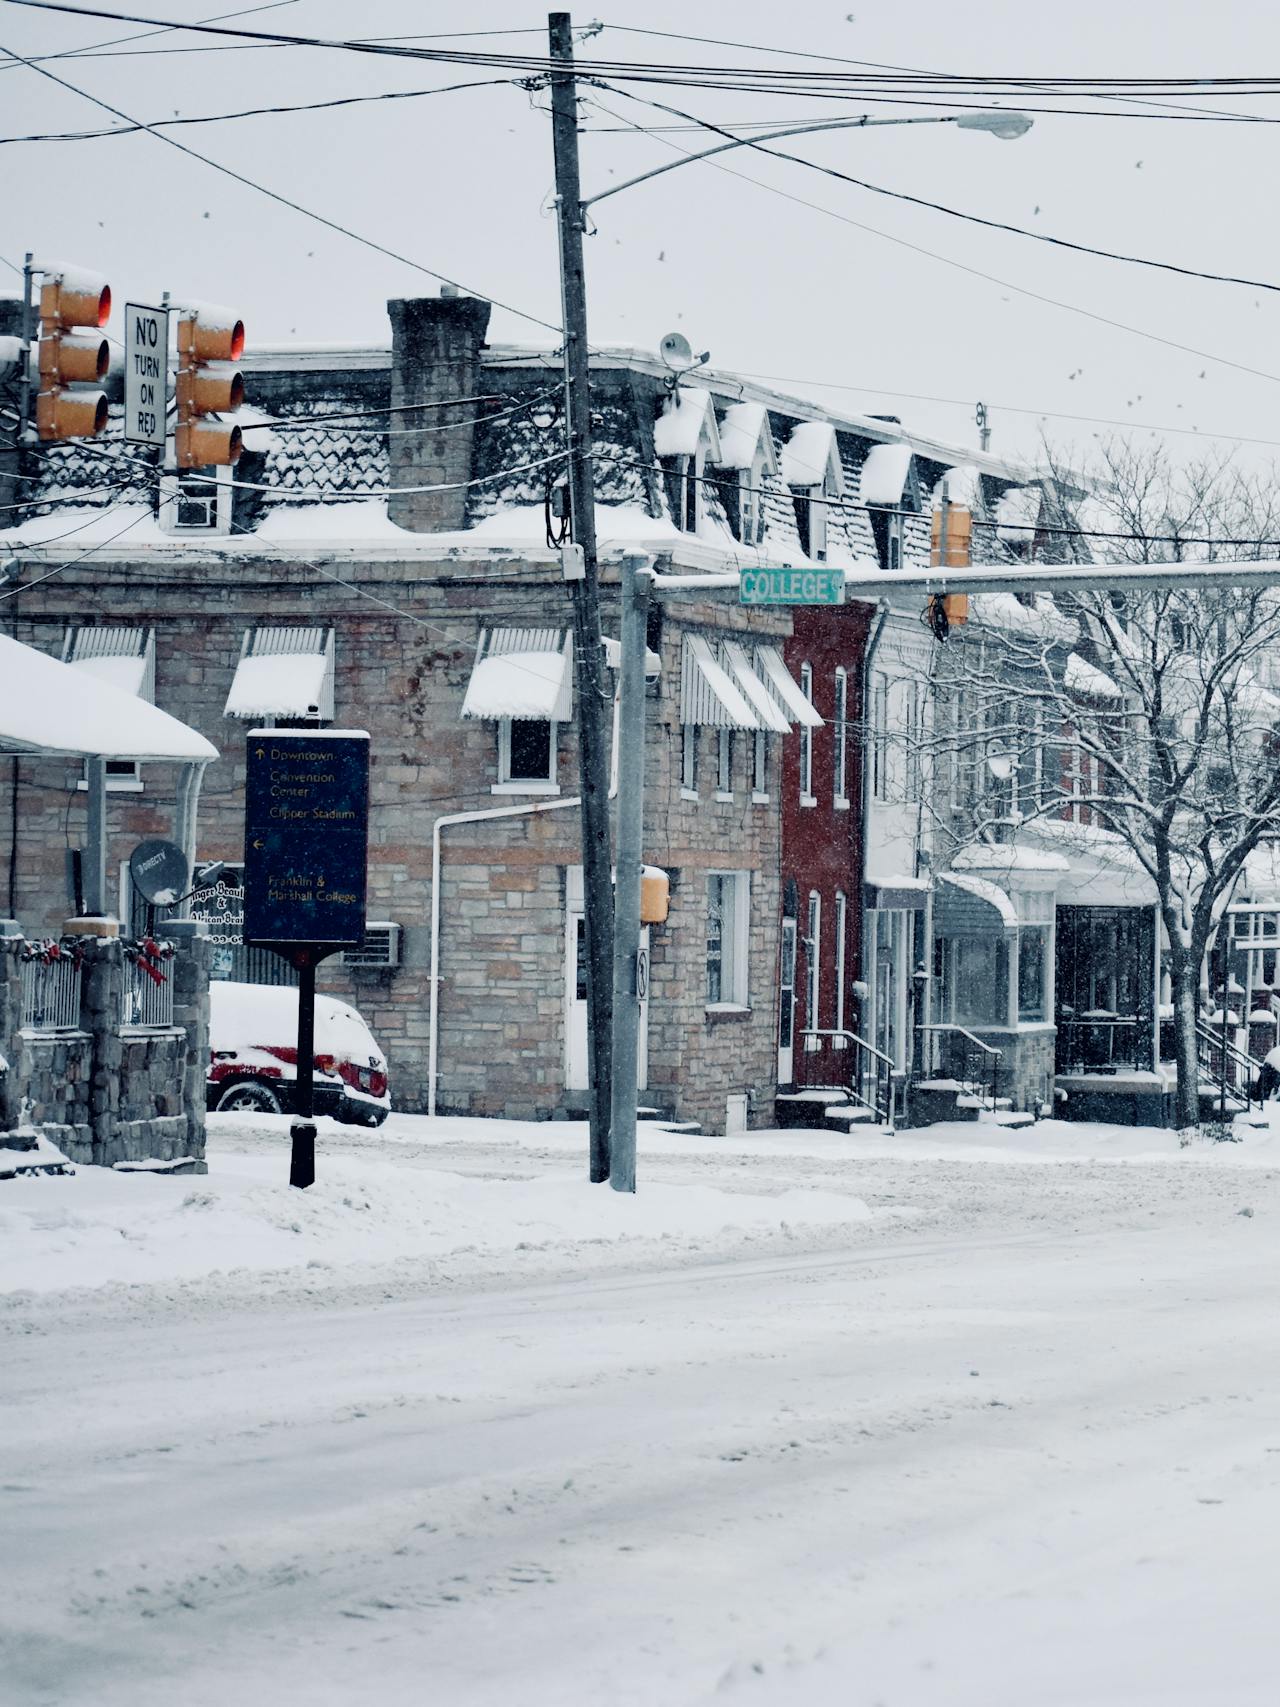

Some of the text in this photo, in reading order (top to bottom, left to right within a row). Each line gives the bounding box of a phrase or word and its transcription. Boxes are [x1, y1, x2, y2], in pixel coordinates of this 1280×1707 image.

[136, 316, 158, 348] NO
[134, 353, 160, 378] TURN
[140, 383, 154, 406] ON
[138, 411, 156, 435] RED
[742, 572, 829, 599] COLLEGE
[271, 749, 333, 761] Downtown
[270, 771, 335, 782] Convention
[270, 785, 309, 797] Center
[270, 807, 355, 819] Clipper Stadium
[268, 875, 325, 887] Franklin &
[267, 890, 356, 904] Marshall College
